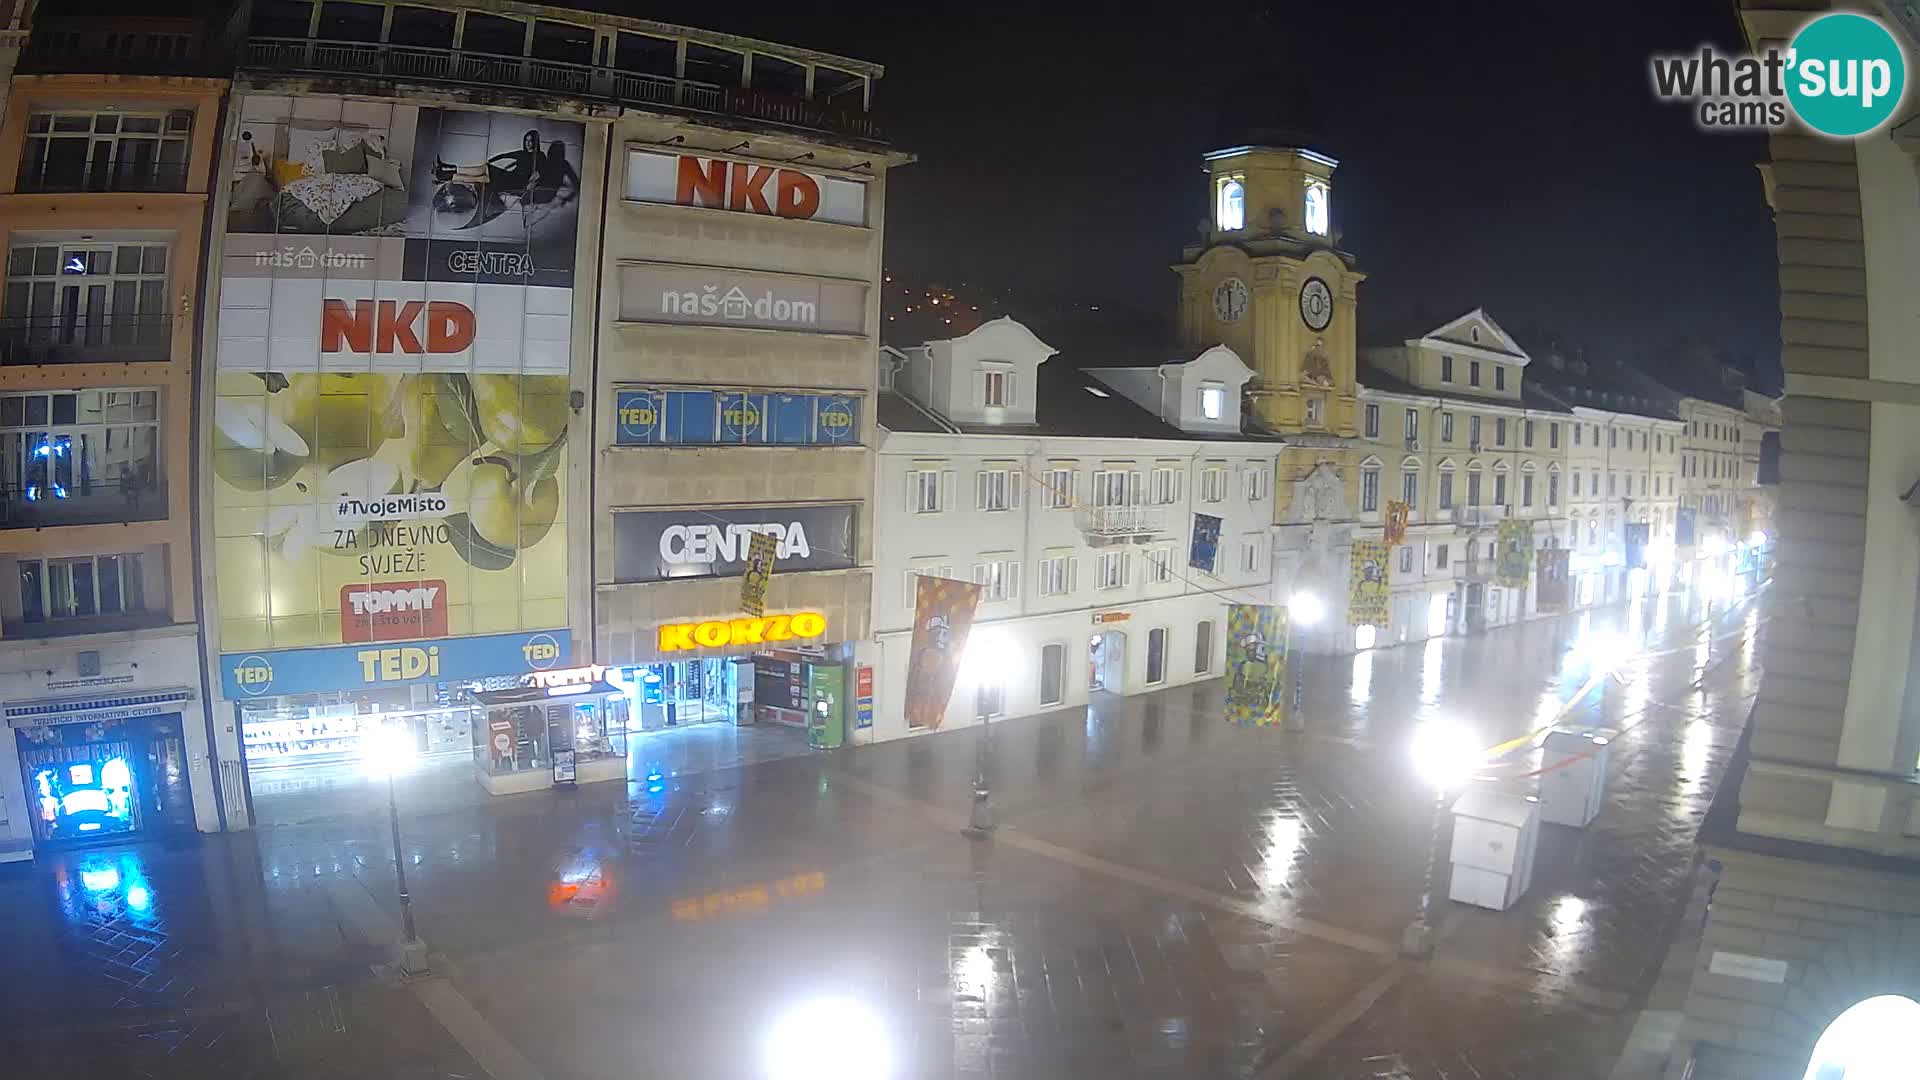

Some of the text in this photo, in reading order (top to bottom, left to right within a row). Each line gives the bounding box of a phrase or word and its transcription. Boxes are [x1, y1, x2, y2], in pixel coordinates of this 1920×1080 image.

[677, 154, 820, 220] NKD
[256, 247, 366, 269] naš dom
[448, 250, 534, 276] CENTRA
[662, 286, 816, 323] naš dom
[320, 298, 476, 355] NKD
[338, 497, 446, 517] #TvojeMisto
[334, 524, 449, 550] ZA DNEVNO
[658, 521, 810, 564] CENTRA
[359, 548, 427, 576] SVJEŽE
[349, 587, 439, 615] TOMMY
[658, 613, 827, 652] KORZO
[358, 646, 441, 683] TEDi
[522, 643, 560, 662] TEDi
[233, 666, 273, 686] TEDi
[532, 664, 606, 689] TOMMY
